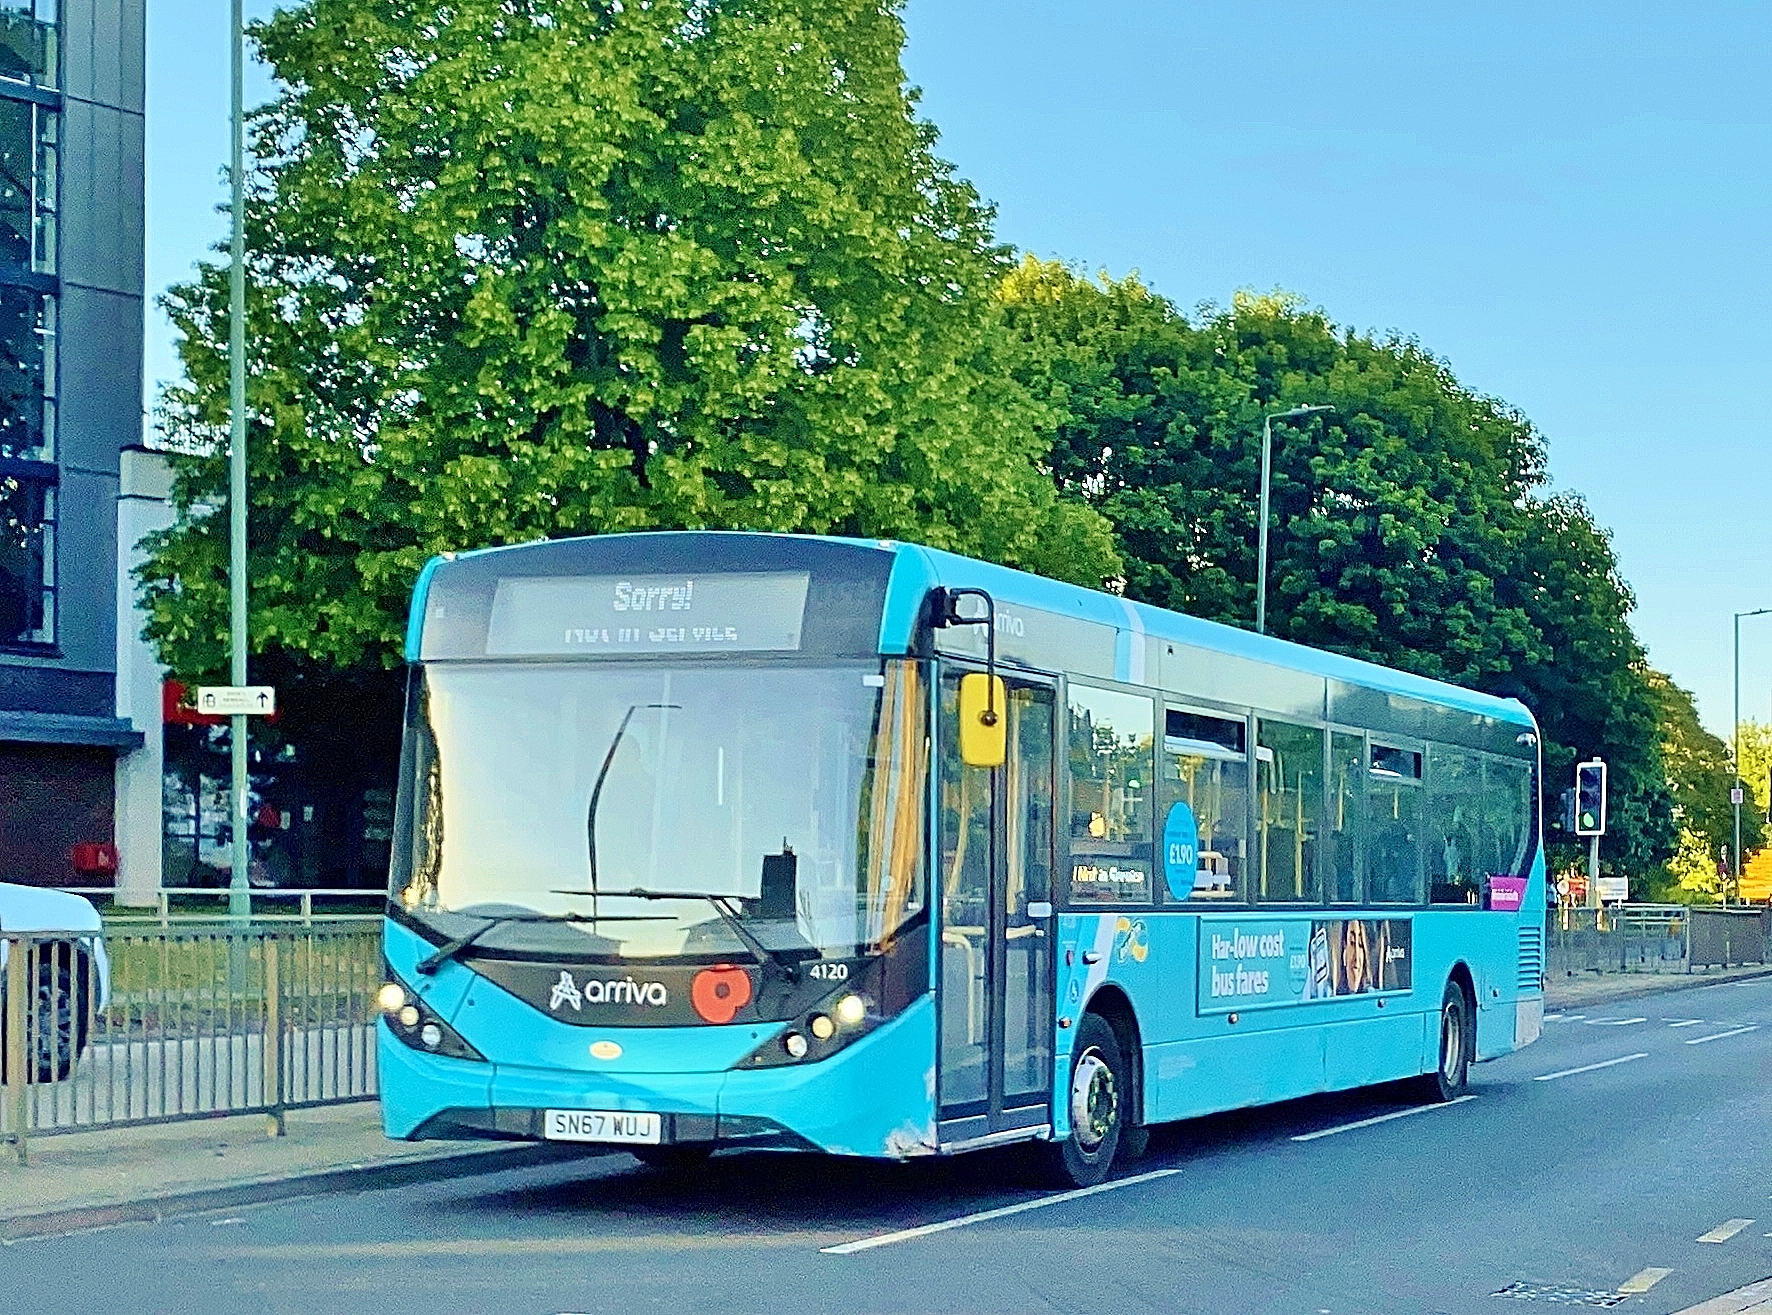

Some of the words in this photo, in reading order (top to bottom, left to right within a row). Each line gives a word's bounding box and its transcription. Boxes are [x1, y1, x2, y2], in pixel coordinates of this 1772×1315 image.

[613, 580, 694, 611] Sorry!
[1211, 927, 1259, 959] Har-low
[1260, 929, 1284, 958] cost
[810, 963, 849, 980] 4120
[1211, 964, 1235, 997] bus
[1236, 963, 1269, 996] fares
[584, 976, 667, 1006] arriva
[556, 1114, 605, 1135] SN67
[613, 1116, 651, 1137] WUJ
